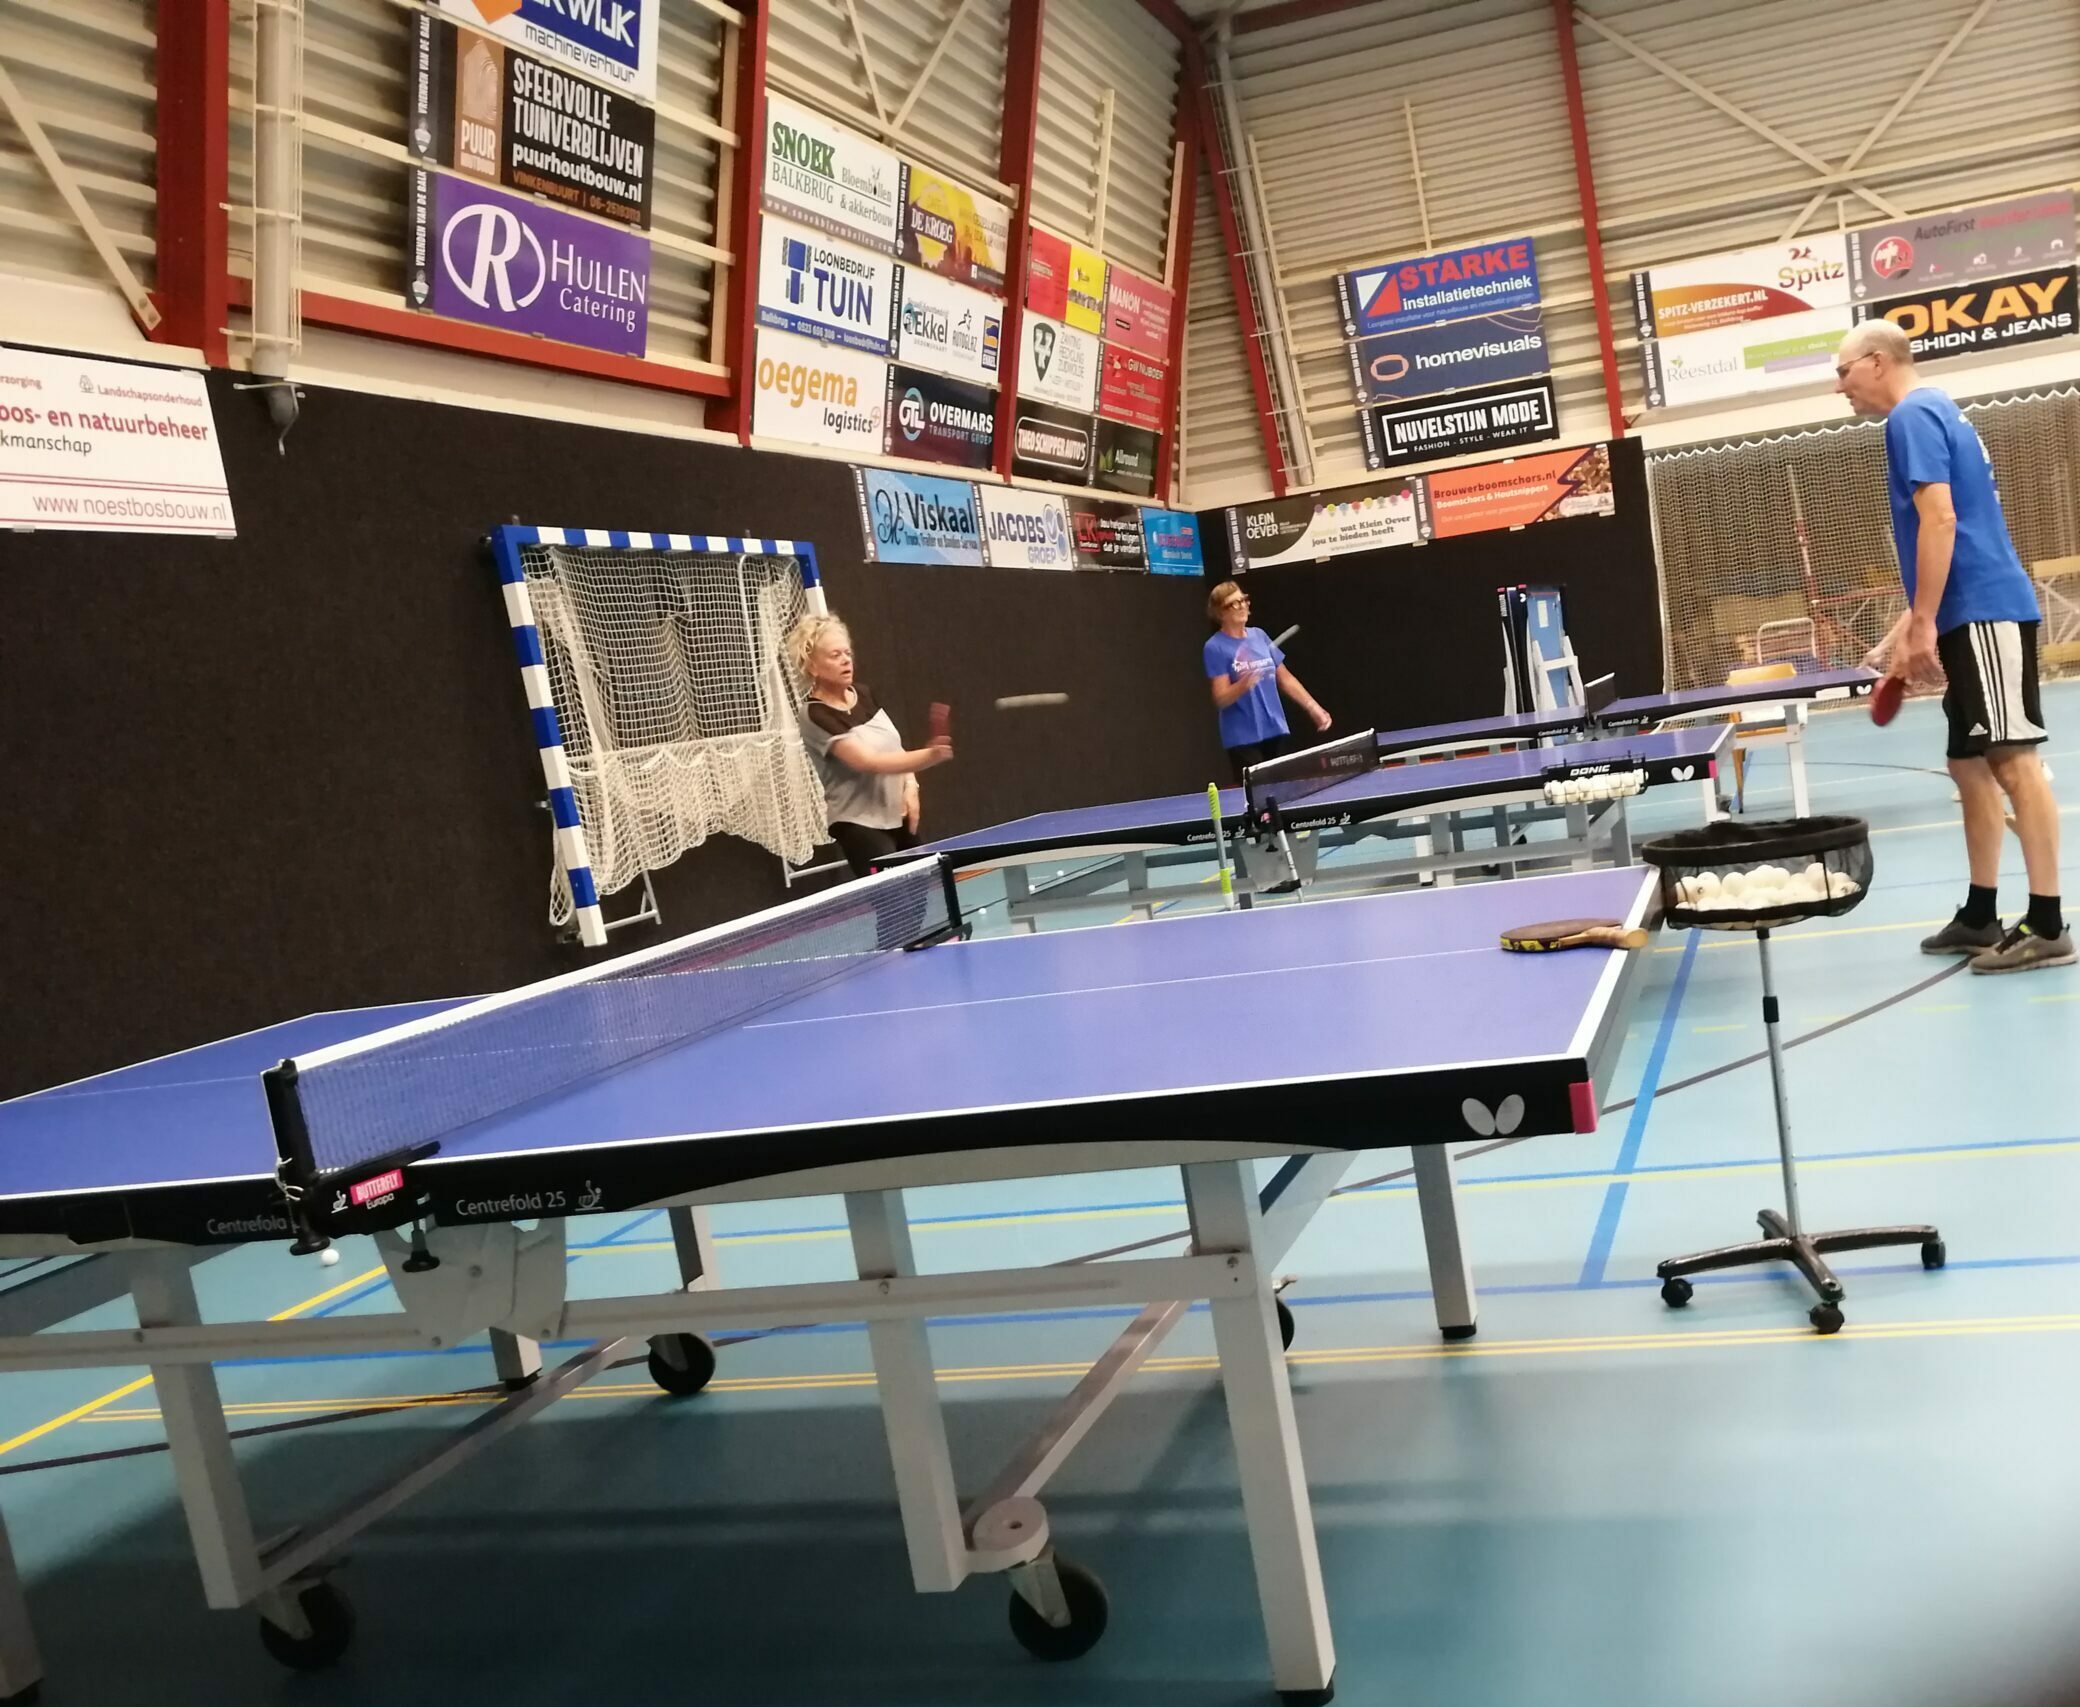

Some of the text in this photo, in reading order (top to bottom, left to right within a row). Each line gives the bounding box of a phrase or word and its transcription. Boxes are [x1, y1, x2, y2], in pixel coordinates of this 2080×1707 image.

[525, 24, 635, 83] machineverhuur
[513, 58, 611, 129] SFEERVOLLE
[461, 119, 497, 159] PUUR
[513, 97, 643, 178] TUINVERBLIJVEN
[771, 121, 836, 180] SNOEK
[512, 143, 643, 203] puurhoutbouw.nl
[771, 161, 834, 204] BALKBRUG
[848, 198, 894, 229] akkerbouw
[1914, 217, 1976, 242] AutoFirst
[552, 240, 646, 305] HULLEN
[813, 247, 875, 280] LOONBEDRIJF
[1399, 244, 1530, 291] STARKE
[1777, 260, 1845, 291] Spitz
[813, 267, 873, 326] TUIN
[1110, 284, 1141, 314] MANON
[1403, 275, 1532, 311] installatietechniek
[1658, 289, 1769, 320] SPITZ-VERZEKERT.NL
[1882, 275, 2070, 339] OKAY
[559, 288, 636, 333] Catering
[914, 310, 948, 344] Ekkel
[1909, 313, 2073, 354] SHION & JEANS
[1416, 334, 1542, 370] homevisuals
[758, 358, 858, 408] oegema
[1666, 356, 1739, 383] Reestdal
[47, 409, 73, 428] en
[78, 412, 209, 441] natuurbeheer
[823, 407, 873, 434] logistics
[928, 425, 970, 441] TRANSPORT
[929, 402, 994, 434] OVERMARS
[1393, 414, 1488, 444] NUVELSTIJN
[1492, 399, 1541, 427] MODE
[1414, 440, 1450, 452] FASHION
[1459, 434, 1484, 445] STYLE
[1492, 428, 1517, 439] WEAR
[1519, 426, 1528, 435] IT
[1433, 470, 1557, 499] Brouwerboomschors.nl
[1436, 483, 1549, 509] Boomschors & Houtsnippers
[904, 492, 975, 534] Viskaal
[988, 511, 1046, 544] JACOBS
[1246, 511, 1275, 527] KLEIN
[1340, 523, 1357, 533] wat
[1358, 519, 1384, 530] Klein
[1384, 515, 1412, 526] Oever
[1246, 523, 1279, 540] OEVER
[1312, 537, 1327, 547] jou
[1328, 534, 1338, 543] te
[1338, 531, 1370, 542] bieden
[1371, 526, 1395, 538] heeft
[1028, 546, 1056, 564] GROEP
[1570, 764, 1611, 776] DONIC
[1186, 832, 1216, 842] Centrefo
[1290, 817, 1336, 830] Centrefold 25
[355, 1173, 400, 1202] BUTTERFLY
[366, 1193, 395, 1211] Europa
[455, 1191, 567, 1217] Centrefold 25
